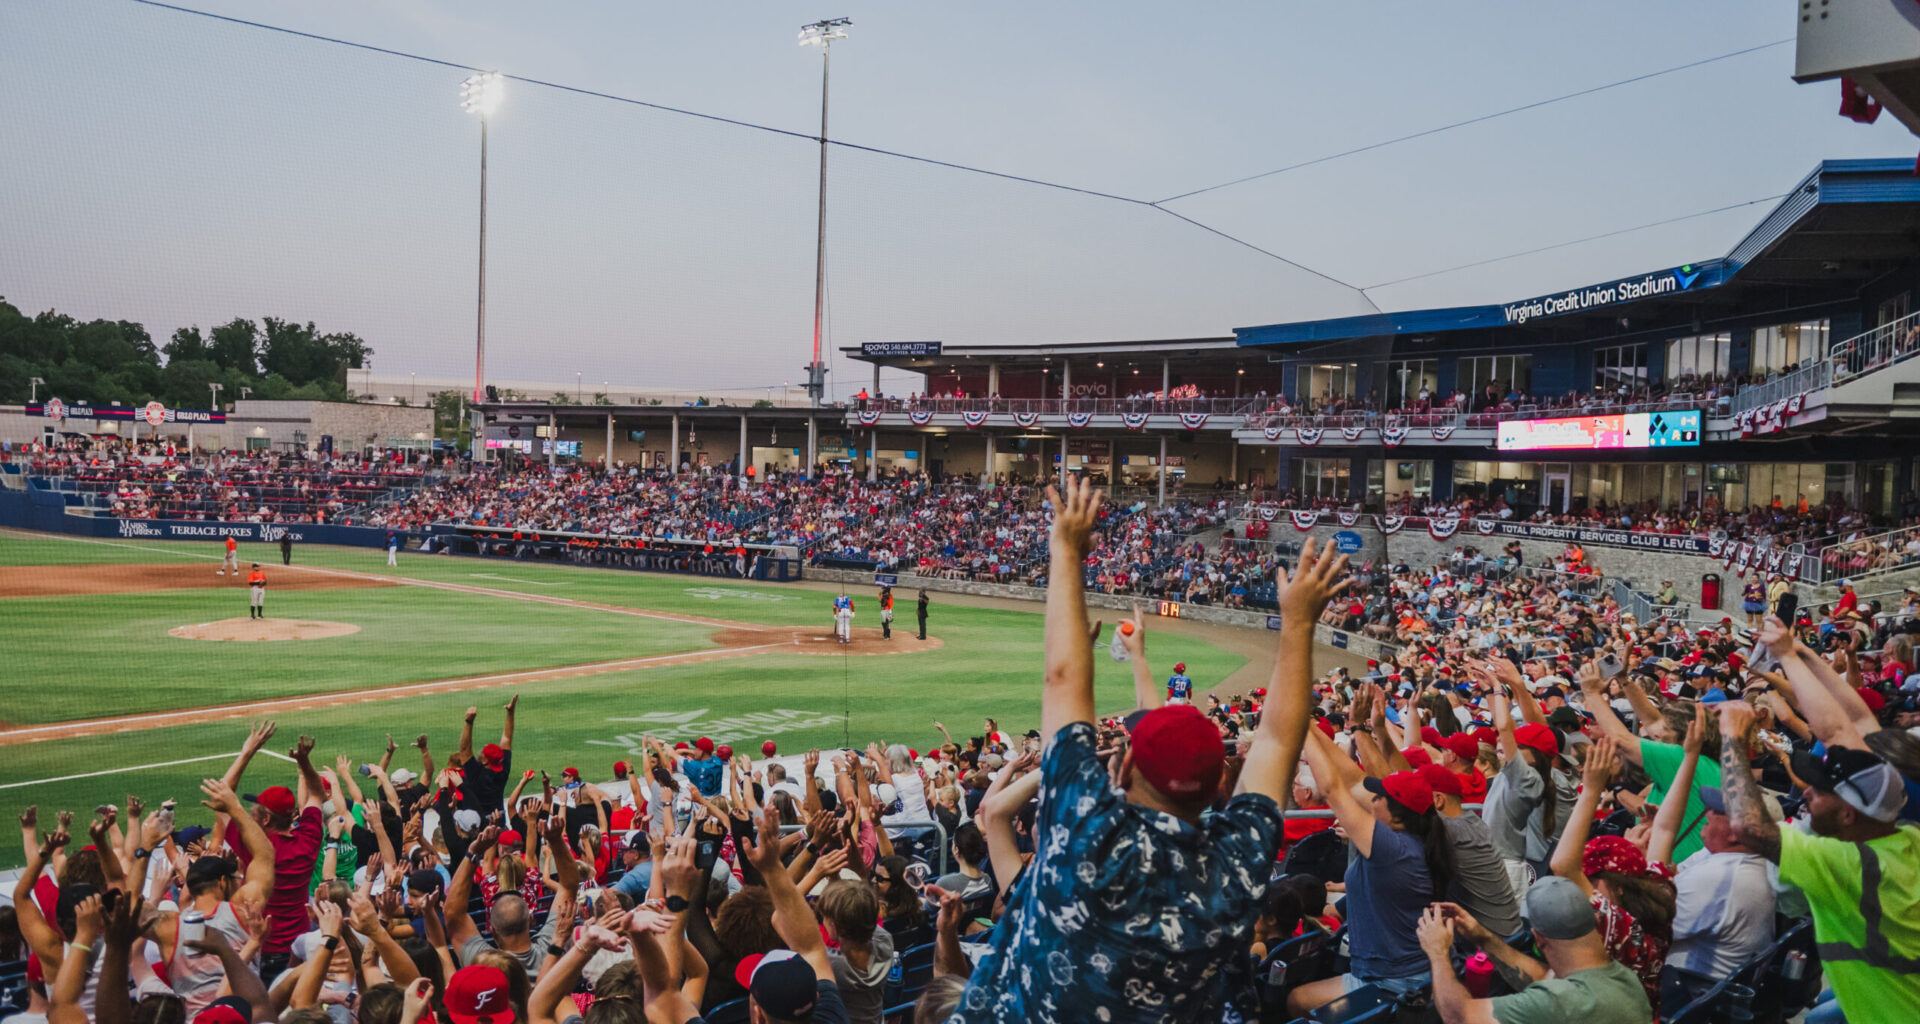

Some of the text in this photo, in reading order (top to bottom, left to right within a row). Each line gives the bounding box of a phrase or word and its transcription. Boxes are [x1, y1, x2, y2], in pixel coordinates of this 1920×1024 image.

[1505, 276, 1676, 324] Virginia Credit Union Stadium
[864, 342, 890, 352] spavia
[193, 412, 211, 421] PLAZA
[119, 519, 148, 529] MARKS
[170, 525, 252, 537] TERRACE BOXES
[1501, 524, 1699, 550] TOTAL PROPERTY SERVICES CLUB LEVEL
[1175, 681, 1186, 691] 20
[585, 708, 822, 748] VIRGINIA
[474, 987, 497, 1011] F
